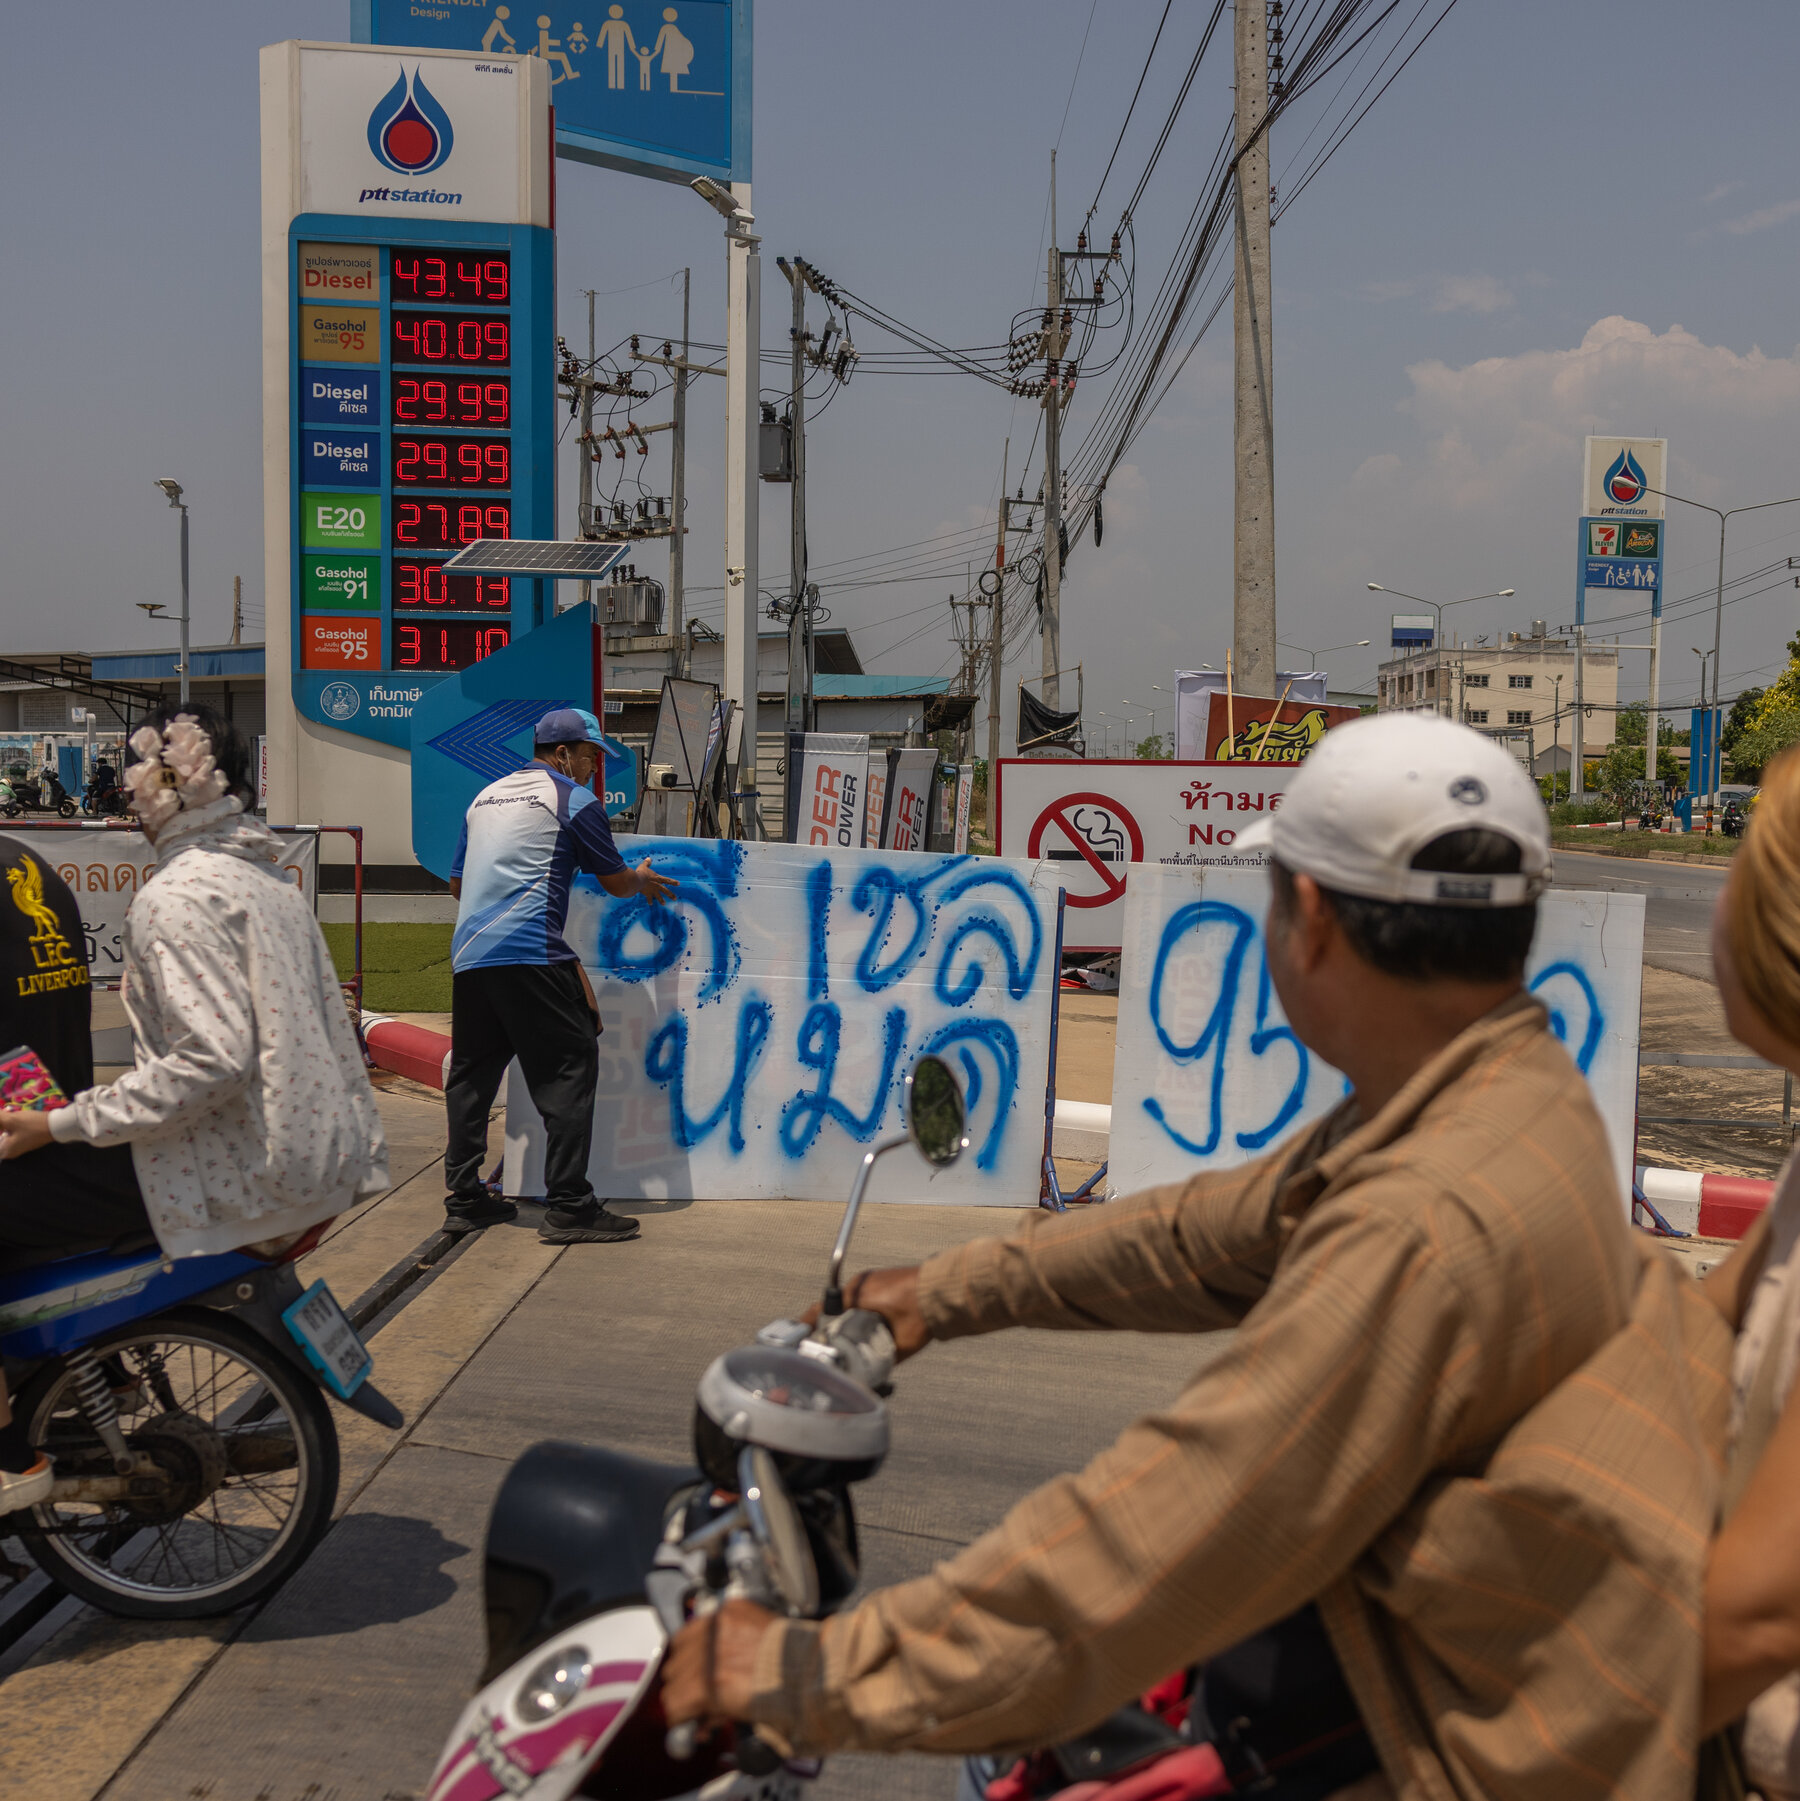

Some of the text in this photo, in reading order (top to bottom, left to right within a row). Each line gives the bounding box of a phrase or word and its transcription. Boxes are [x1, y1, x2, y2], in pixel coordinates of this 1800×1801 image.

[410, 6, 450, 20] Design
[305, 256, 372, 268] ซูเปอร์พาวเวอร์
[304, 268, 372, 290] Diesel
[395, 258, 508, 300] 43.49
[313, 318, 366, 332] Gasohol
[339, 331, 365, 351] 95
[395, 319, 508, 361] 40.09
[312, 382, 368, 400] Diesel
[396, 380, 508, 422] 29.99
[339, 400, 368, 414] ดีเซล
[313, 441, 368, 459] Diesel
[340, 459, 368, 472] ดีเซล
[396, 442, 508, 484] 29.99
[317, 506, 366, 530] E20
[397, 503, 509, 544] 27.89
[315, 566, 368, 579] Gasohol
[343, 579, 368, 600] 91
[399, 565, 509, 606] 30.13
[314, 627, 368, 640] Gasohol
[340, 640, 368, 660] 95
[1188, 823, 1237, 846] No
